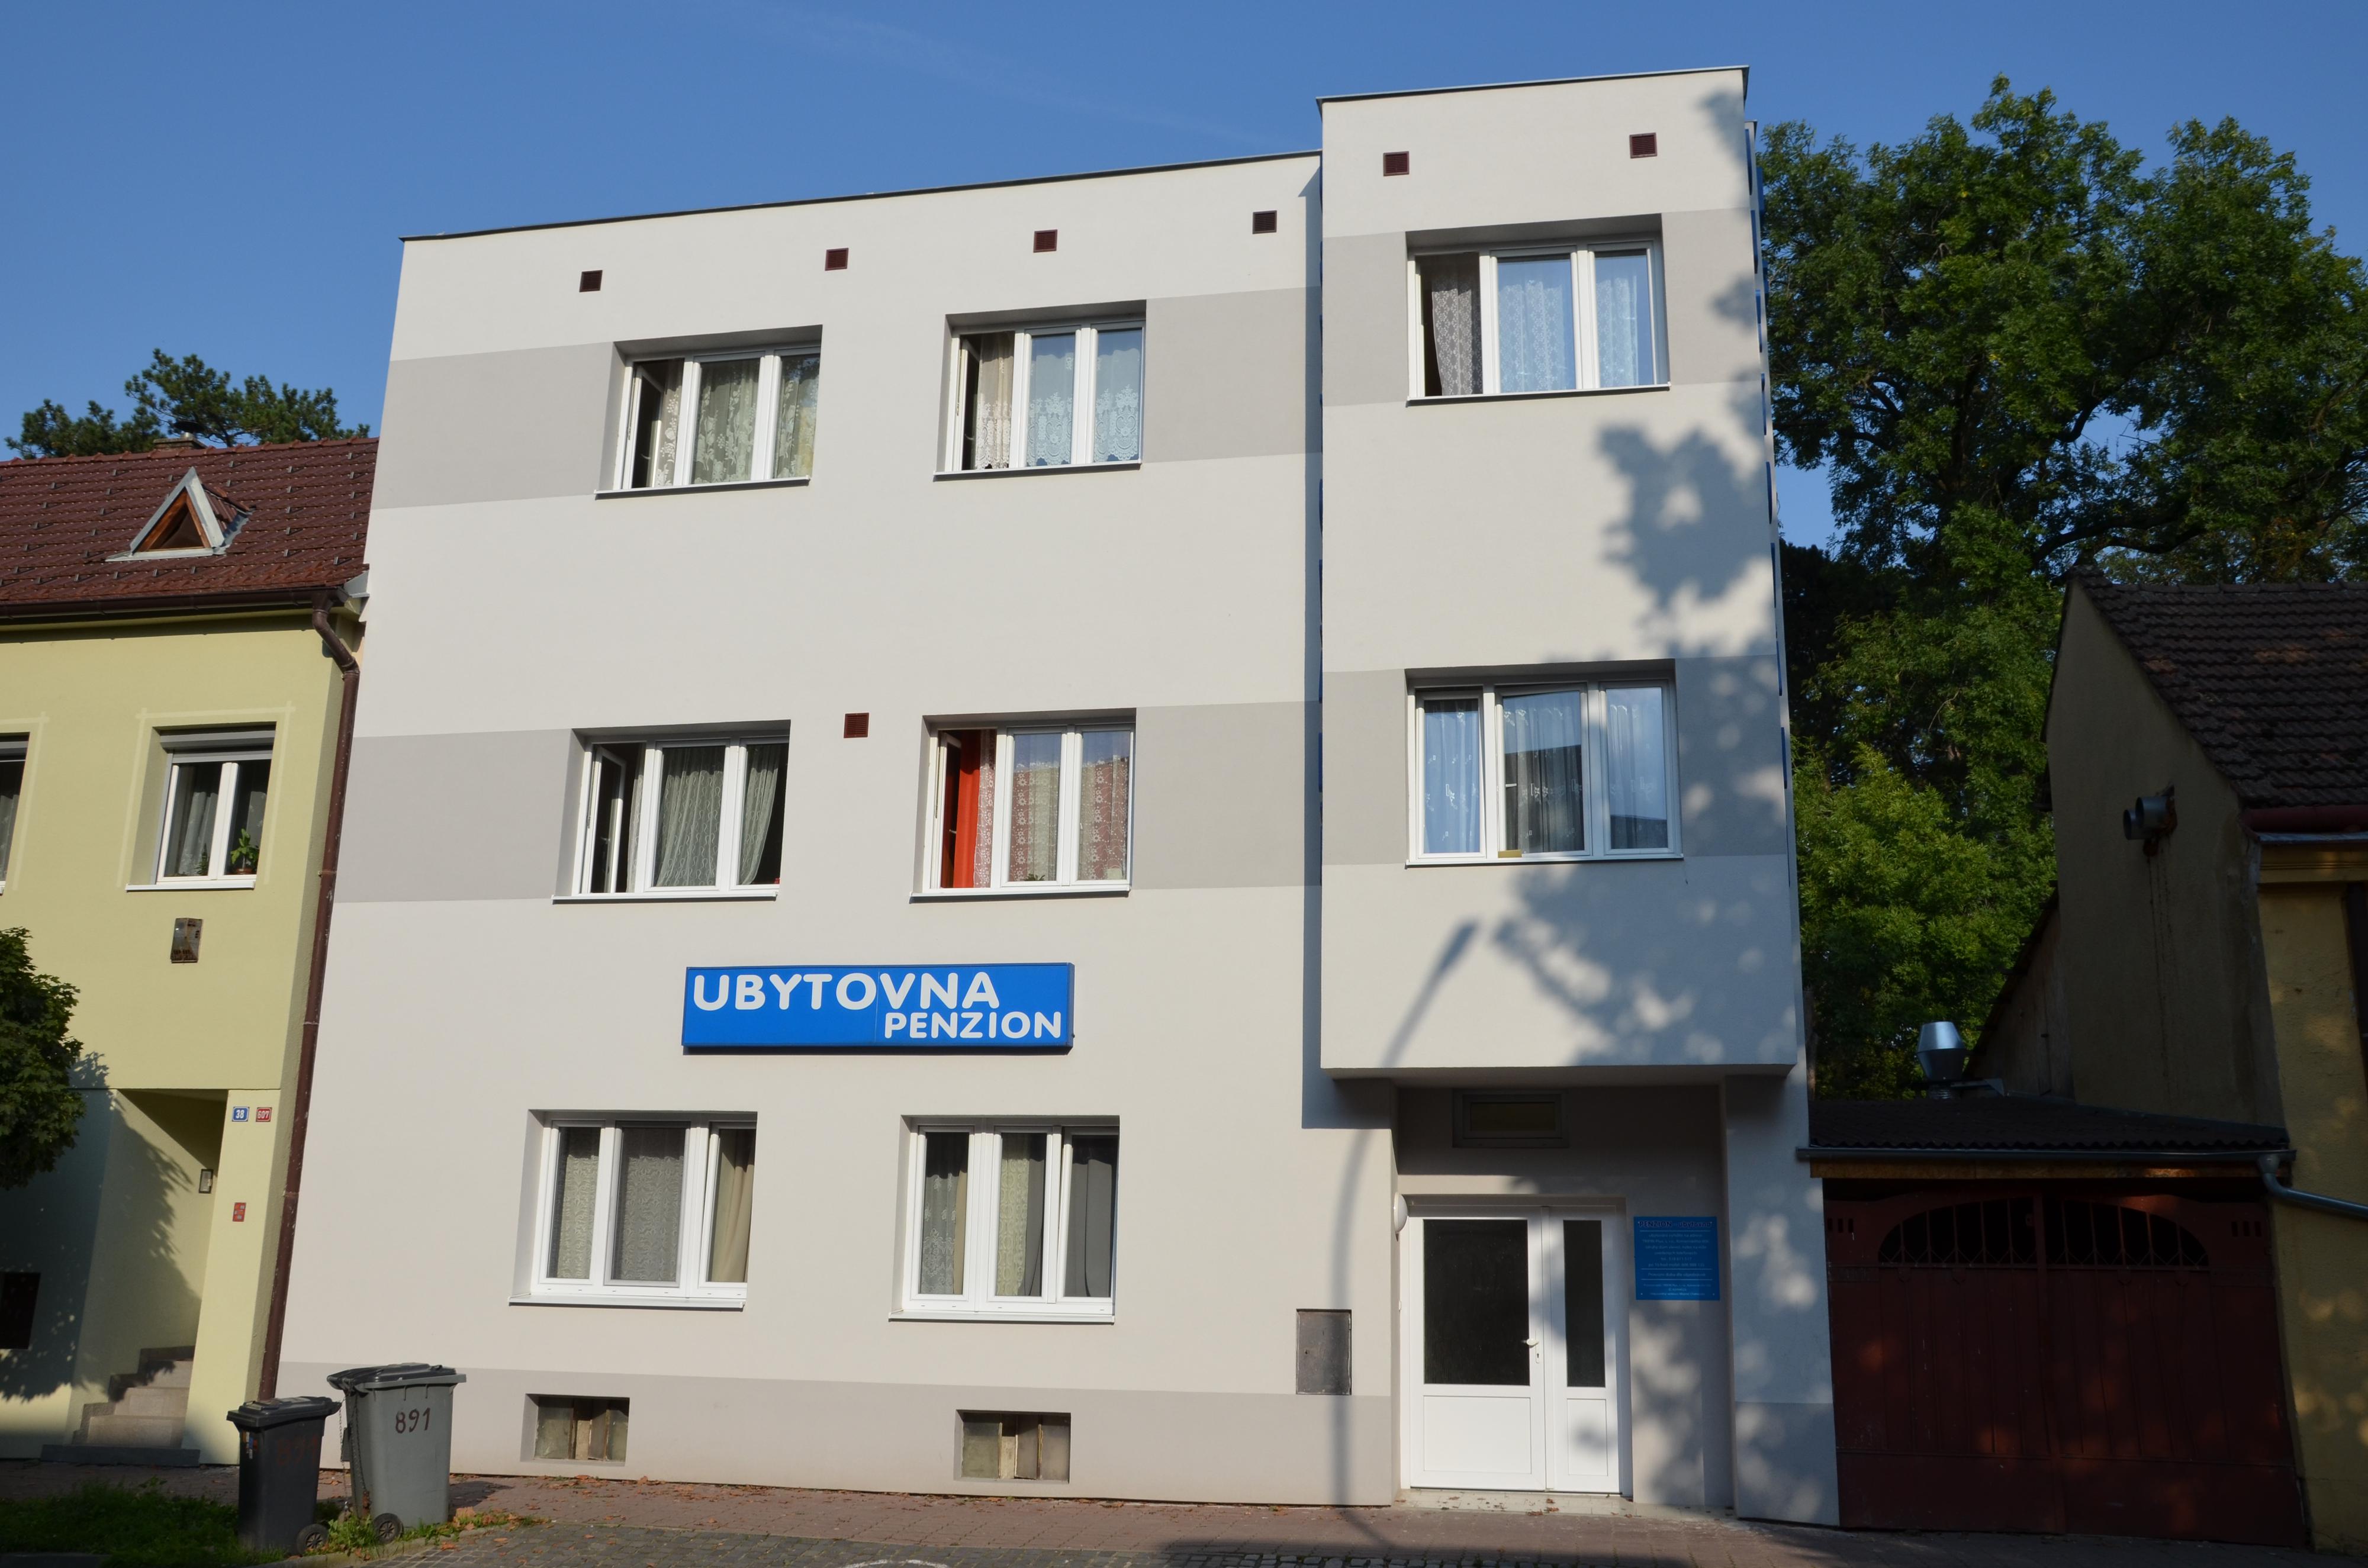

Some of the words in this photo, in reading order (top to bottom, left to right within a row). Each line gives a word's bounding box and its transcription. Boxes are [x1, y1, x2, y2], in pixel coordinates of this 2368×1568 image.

[693, 972, 1000, 1010] UBYTOVNA
[884, 1011, 1061, 1039] PENZION
[236, 1109, 244, 1119] 38
[258, 1110, 269, 1119] 607
[395, 1407, 431, 1434] 891
